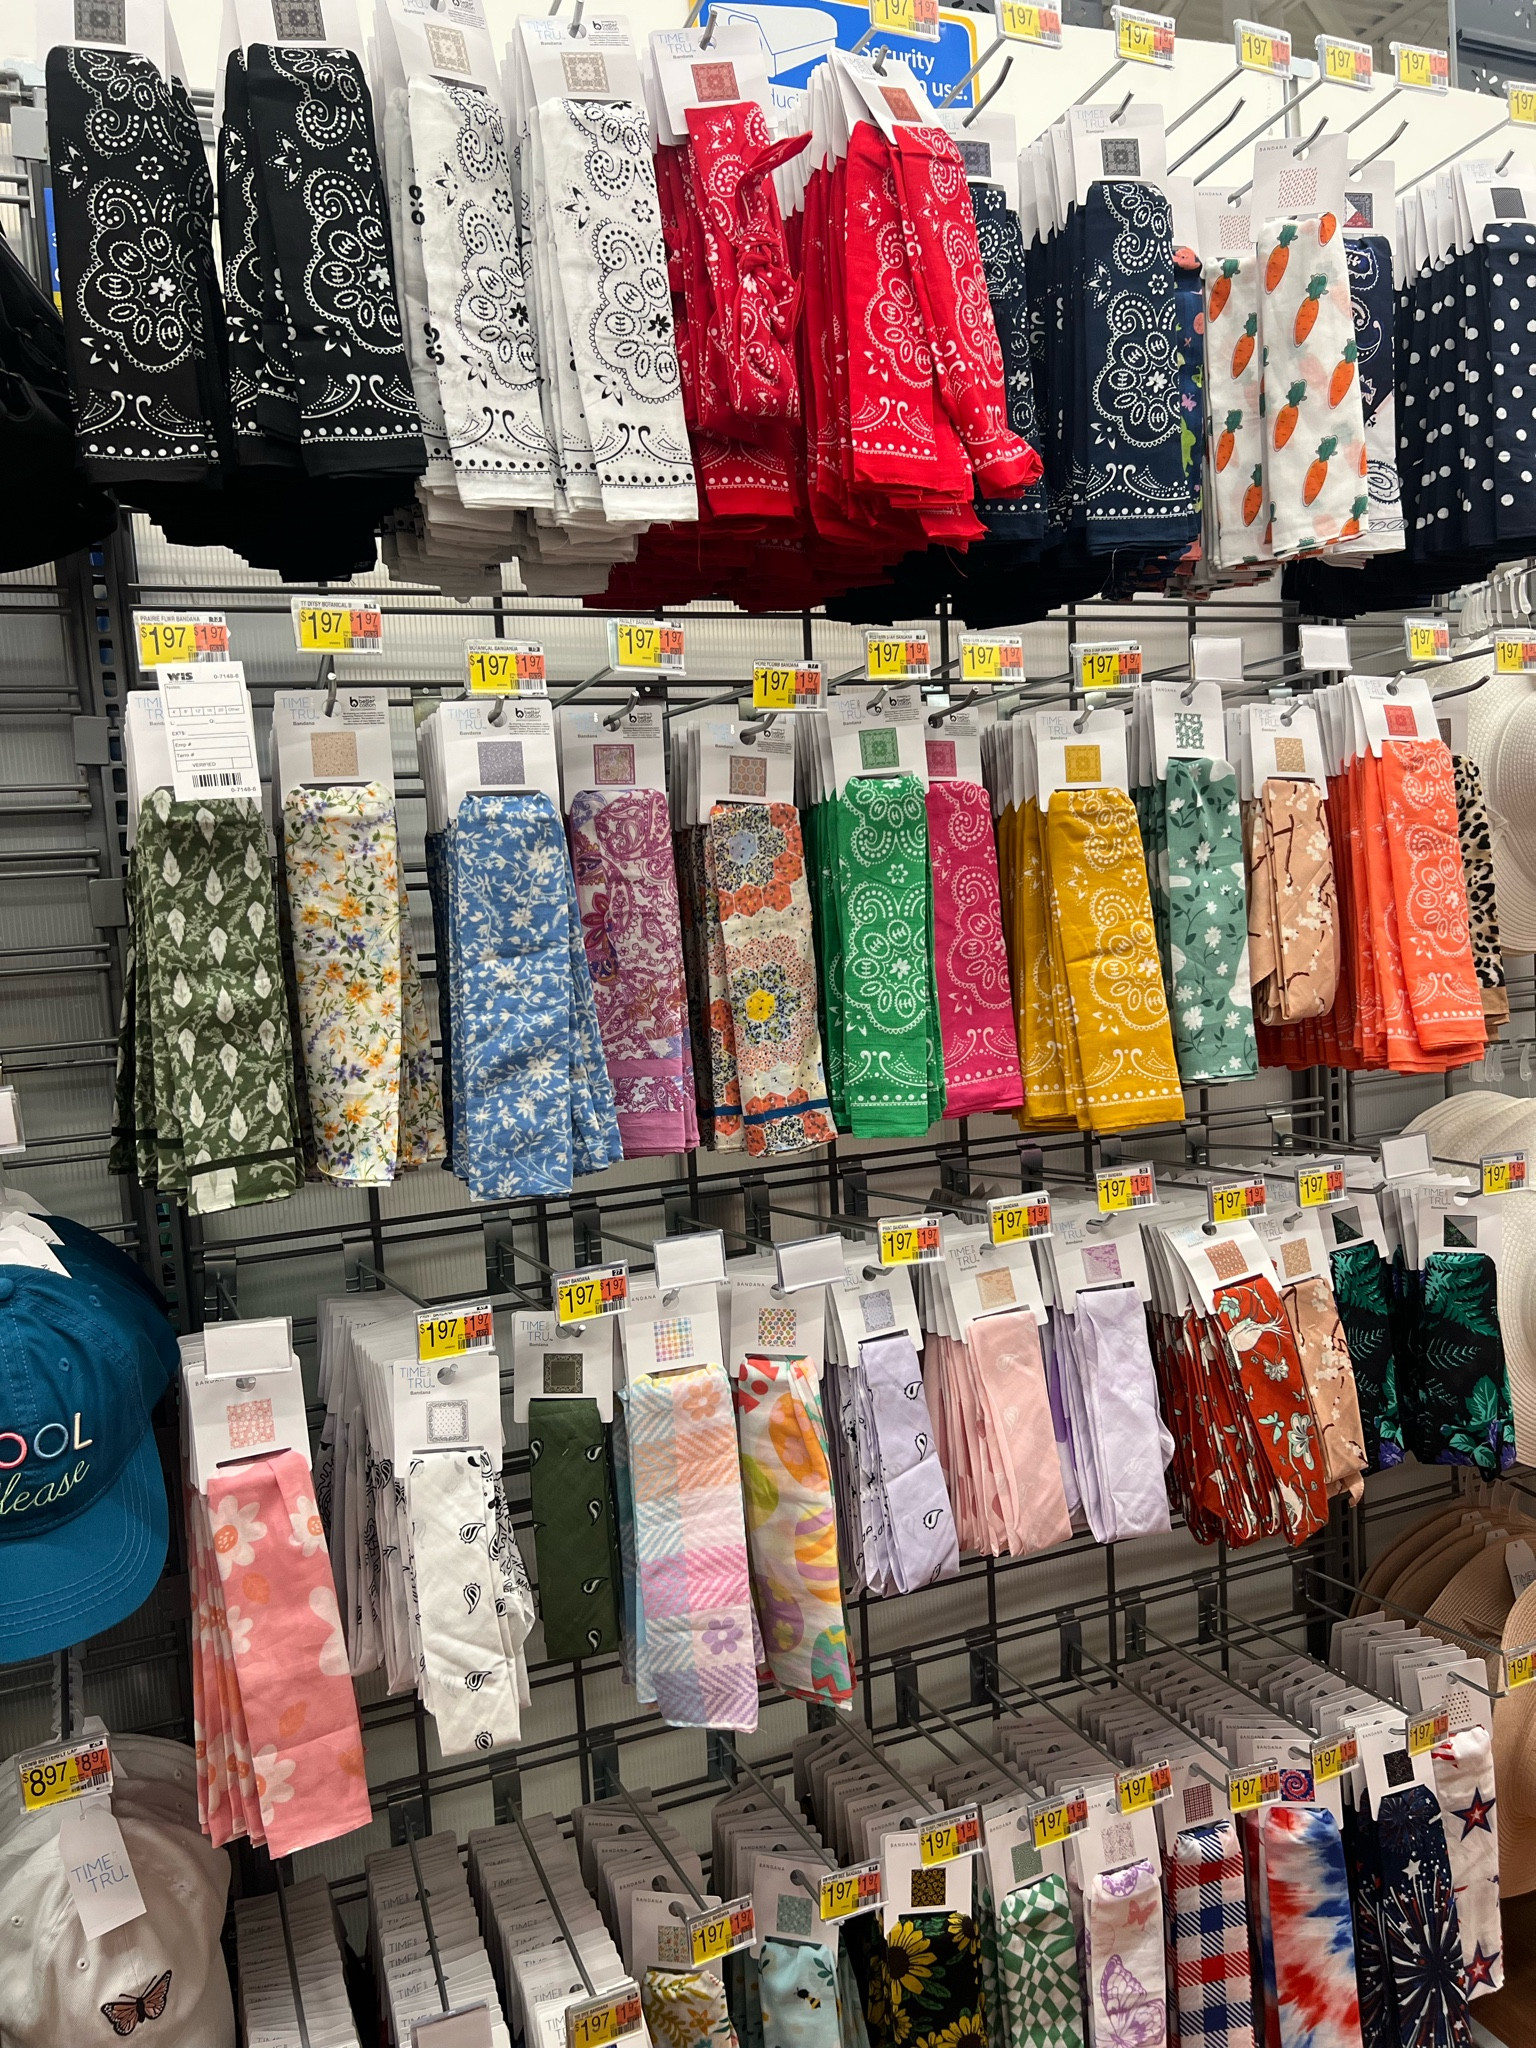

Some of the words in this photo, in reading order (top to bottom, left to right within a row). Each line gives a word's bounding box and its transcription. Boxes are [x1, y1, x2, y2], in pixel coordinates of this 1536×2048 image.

[1259, 144, 1288, 152] BANDANA
[300, 610, 343, 639] $197
[140, 626, 187, 656] $197
[618, 628, 654, 654] $197
[469, 654, 509, 682] $197
[868, 643, 900, 668] $197
[962, 646, 994, 670] $197
[1082, 655, 1113, 680] $197
[754, 670, 790, 697] $197
[280, 696, 310, 709] TIME
[447, 708, 475, 719] TIME
[1041, 716, 1063, 726] TIME
[1299, 1176, 1323, 1199] $197
[1483, 1165, 1506, 1187] $197
[1098, 1179, 1126, 1204] $197
[1213, 1191, 1241, 1215] $197
[992, 1210, 1023, 1235] $197
[882, 1232, 912, 1257] $197
[558, 1284, 595, 1313] $197
[420, 1318, 458, 1348] $197
[520, 1320, 544, 1331] TIME
[528, 1331, 549, 1341] TRU
[400, 1366, 426, 1378] TIME
[408, 1377, 431, 1389] TRU
[22, 1760, 68, 1797] $897
[1119, 1776, 1146, 1804] $197
[1230, 1778, 1256, 1803] $197
[1034, 1809, 1063, 1837] $197
[920, 1829, 951, 1857] $197
[71, 1853, 113, 1883] TIME
[87, 1865, 125, 1893] TRU
[821, 1879, 853, 1908] $197
[692, 1920, 725, 1952] $197
[574, 2011, 610, 2042] $197
